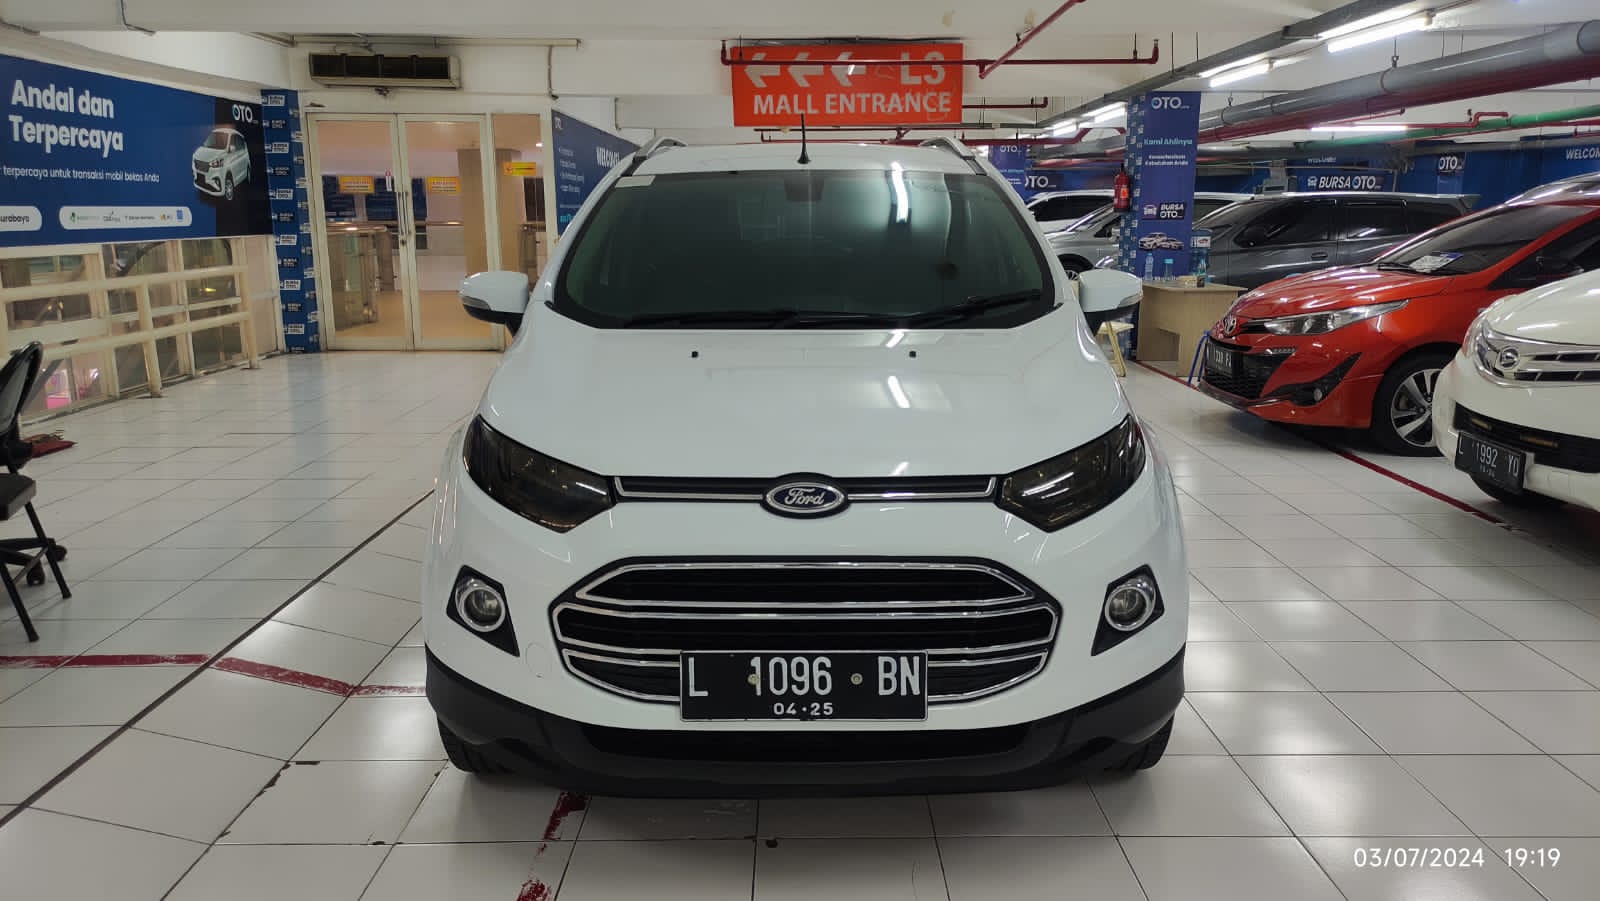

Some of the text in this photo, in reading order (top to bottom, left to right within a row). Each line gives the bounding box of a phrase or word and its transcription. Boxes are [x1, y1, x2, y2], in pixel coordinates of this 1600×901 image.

[11, 80, 114, 119] Andal dan
[753, 92, 951, 114] MALL ENTRANCE
[1151, 96, 1181, 109] OTO
[232, 103, 253, 123] OTO
[8, 114, 124, 158] Terpercaya
[1439, 156, 1458, 170] OTO
[3, 165, 48, 181] terpercaya
[50, 168, 71, 179] untuk
[73, 169, 104, 180] transaksi
[105, 171, 123, 181] mobil
[1319, 175, 1376, 189] BURSA OTO
[1160, 210, 1178, 218] OTO
[1458, 435, 1464, 455] L
[1475, 442, 1498, 468] 1992
[784, 487, 826, 505] Ford
[688, 656, 921, 697] L 1096 BN
